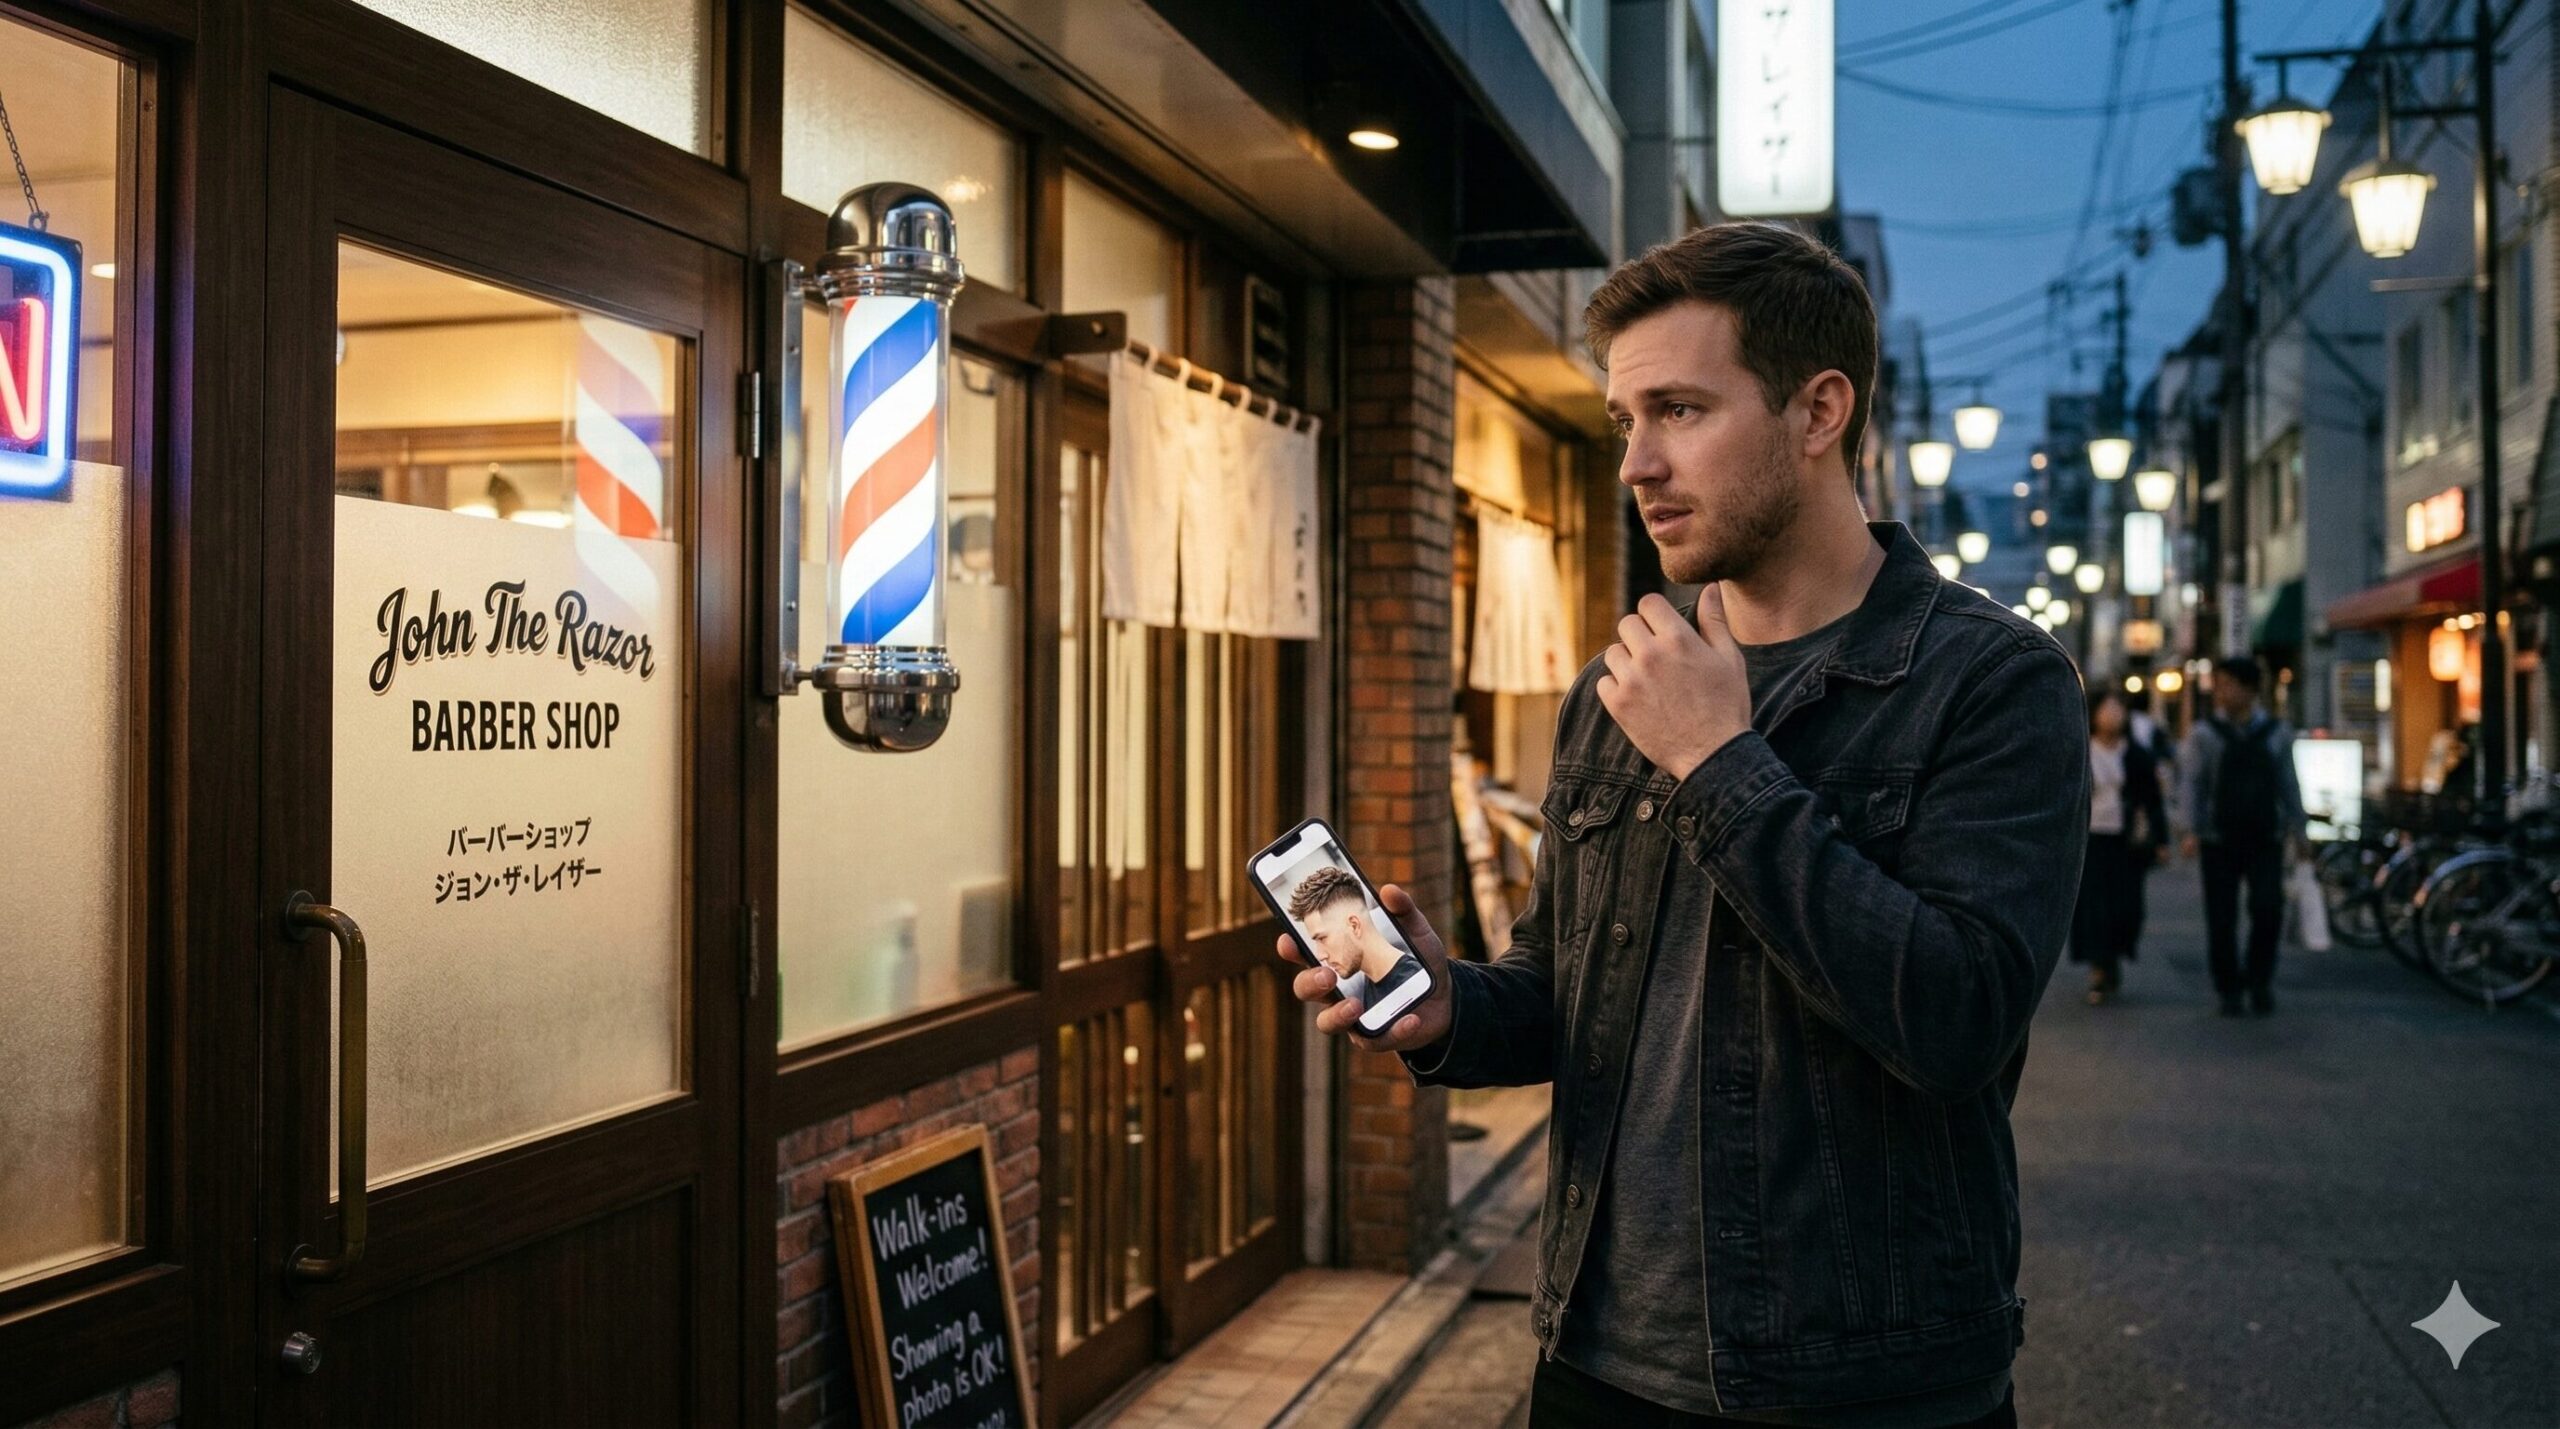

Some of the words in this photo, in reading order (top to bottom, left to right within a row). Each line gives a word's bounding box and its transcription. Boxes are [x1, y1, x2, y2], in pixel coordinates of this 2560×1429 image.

[368, 587, 478, 692] John
[484, 578, 549, 655] The
[555, 589, 656, 679] Razor
[411, 699, 537, 752] BARBER
[546, 700, 620, 750] SHOP
[446, 816, 592, 857] バーバーショップ
[434, 856, 602, 905] ジョン・ザ・レイザー
[872, 1192, 968, 1262] Walk-ins
[896, 1226, 988, 1310] Welcome!
[891, 1319, 965, 1381] Showing
[968, 1310, 984, 1336] a
[903, 1378, 952, 1429] photo
[953, 1366, 972, 1398] is
[971, 1333, 1006, 1387] OK!
